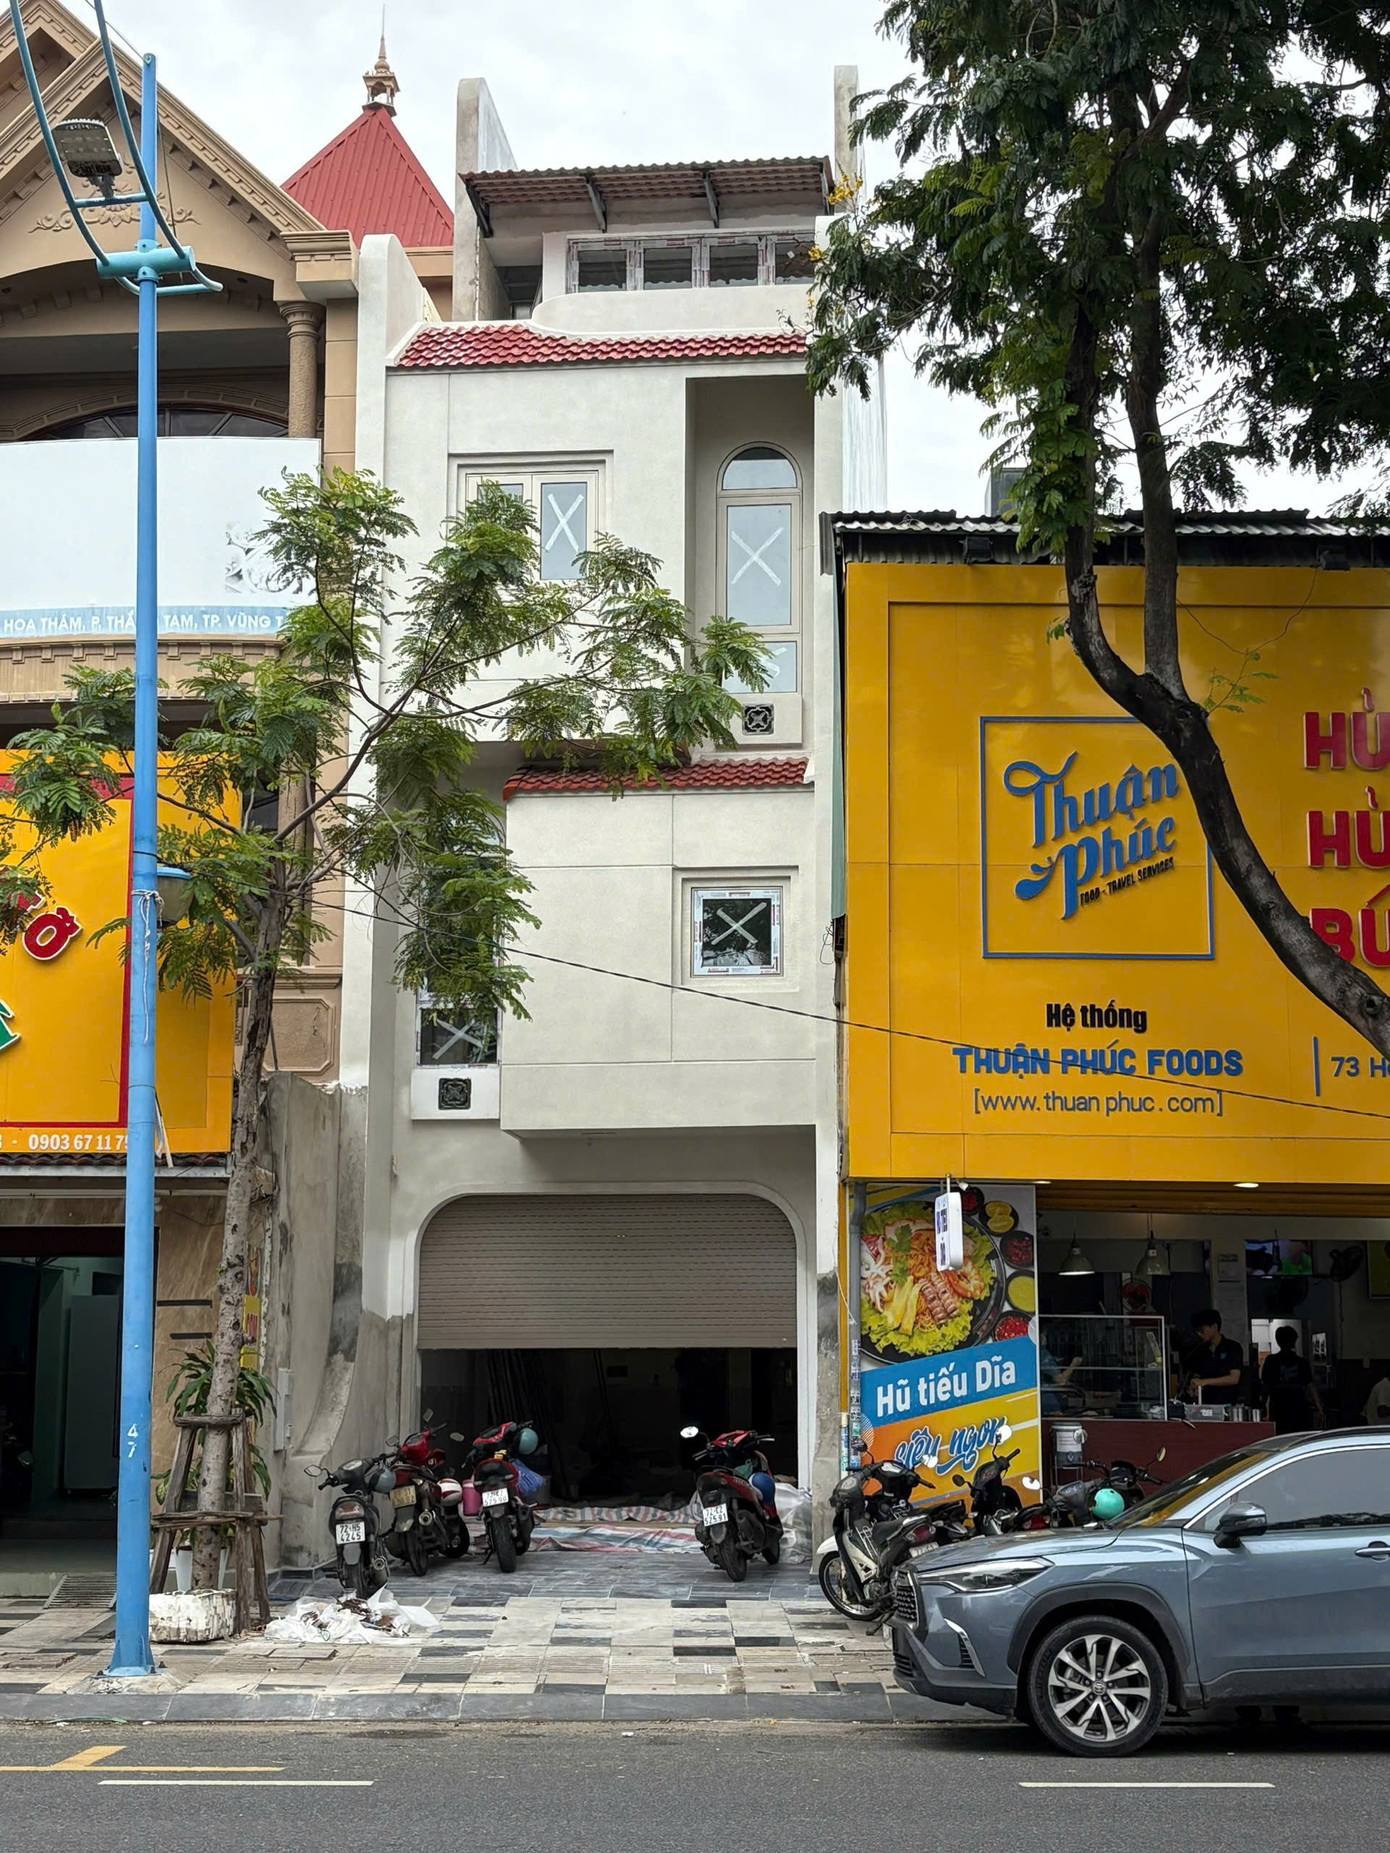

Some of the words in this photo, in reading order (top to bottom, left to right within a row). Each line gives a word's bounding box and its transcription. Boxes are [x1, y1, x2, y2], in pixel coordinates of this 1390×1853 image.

[3, 618, 36, 632] HOA
[1003, 751, 1180, 848] Thuận
[1014, 816, 1176, 921] Phúc
[1080, 887, 1100, 907] FOOD
[1106, 873, 1136, 894] TRAVEL
[1137, 857, 1174, 881] SERVICES
[1046, 1003, 1075, 1031] Hệ
[1080, 1000, 1147, 1034] thống
[952, 1042, 1050, 1079] THUẬN
[1060, 1039, 1136, 1076] PHÚC
[1147, 1049, 1243, 1076] FOODS
[1331, 1056, 1360, 1078] 73
[28, 1134, 70, 1150] 0903
[73, 1134, 93, 1150] 67
[96, 1134, 112, 1150] 11
[877, 1379, 911, 1417] Hũ
[917, 1362, 968, 1406] tiếu
[976, 1355, 1016, 1392] Dĩa
